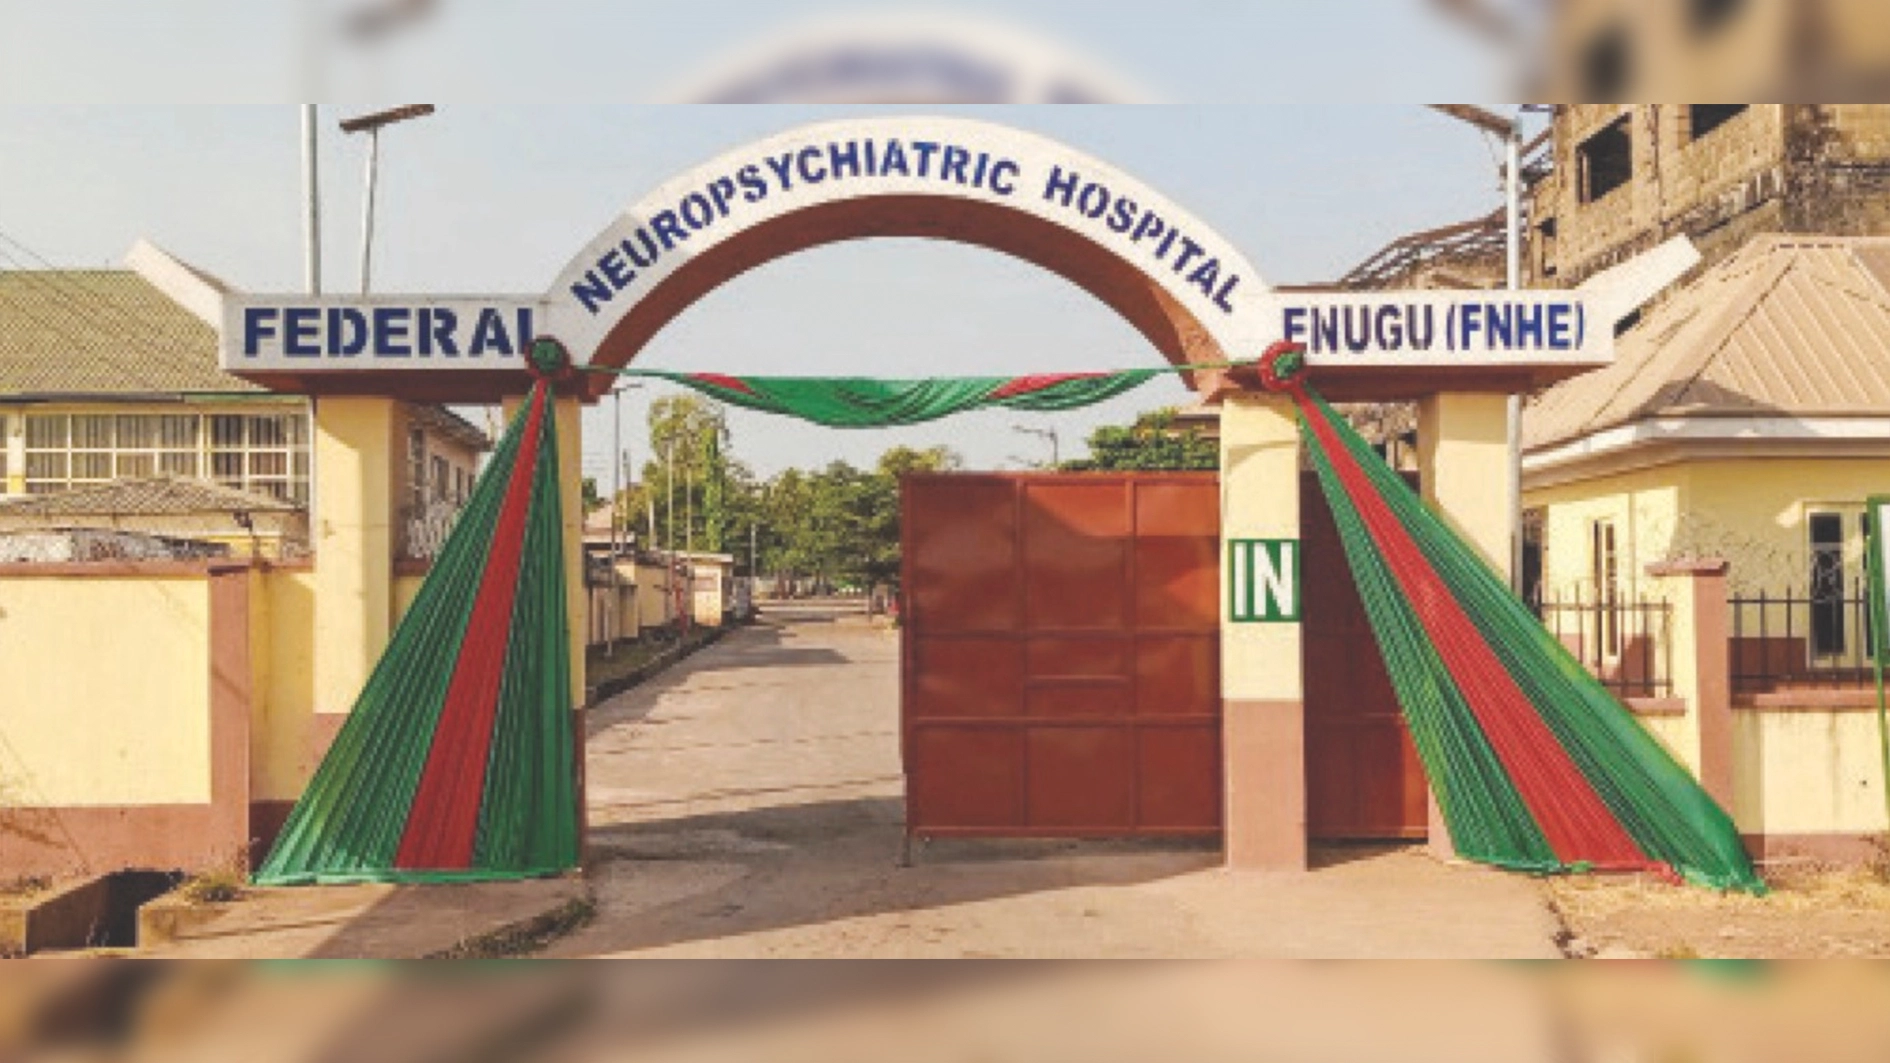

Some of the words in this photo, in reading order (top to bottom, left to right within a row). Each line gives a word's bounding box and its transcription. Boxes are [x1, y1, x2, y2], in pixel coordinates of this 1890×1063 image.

[571, 138, 1020, 313] NEUROPSYCHIATRIC
[1043, 165, 1240, 313] HOSPITAL
[1283, 303, 1433, 353] ENUGU
[1446, 302, 1585, 350] (FNHE)
[1234, 541, 1294, 618] IN
